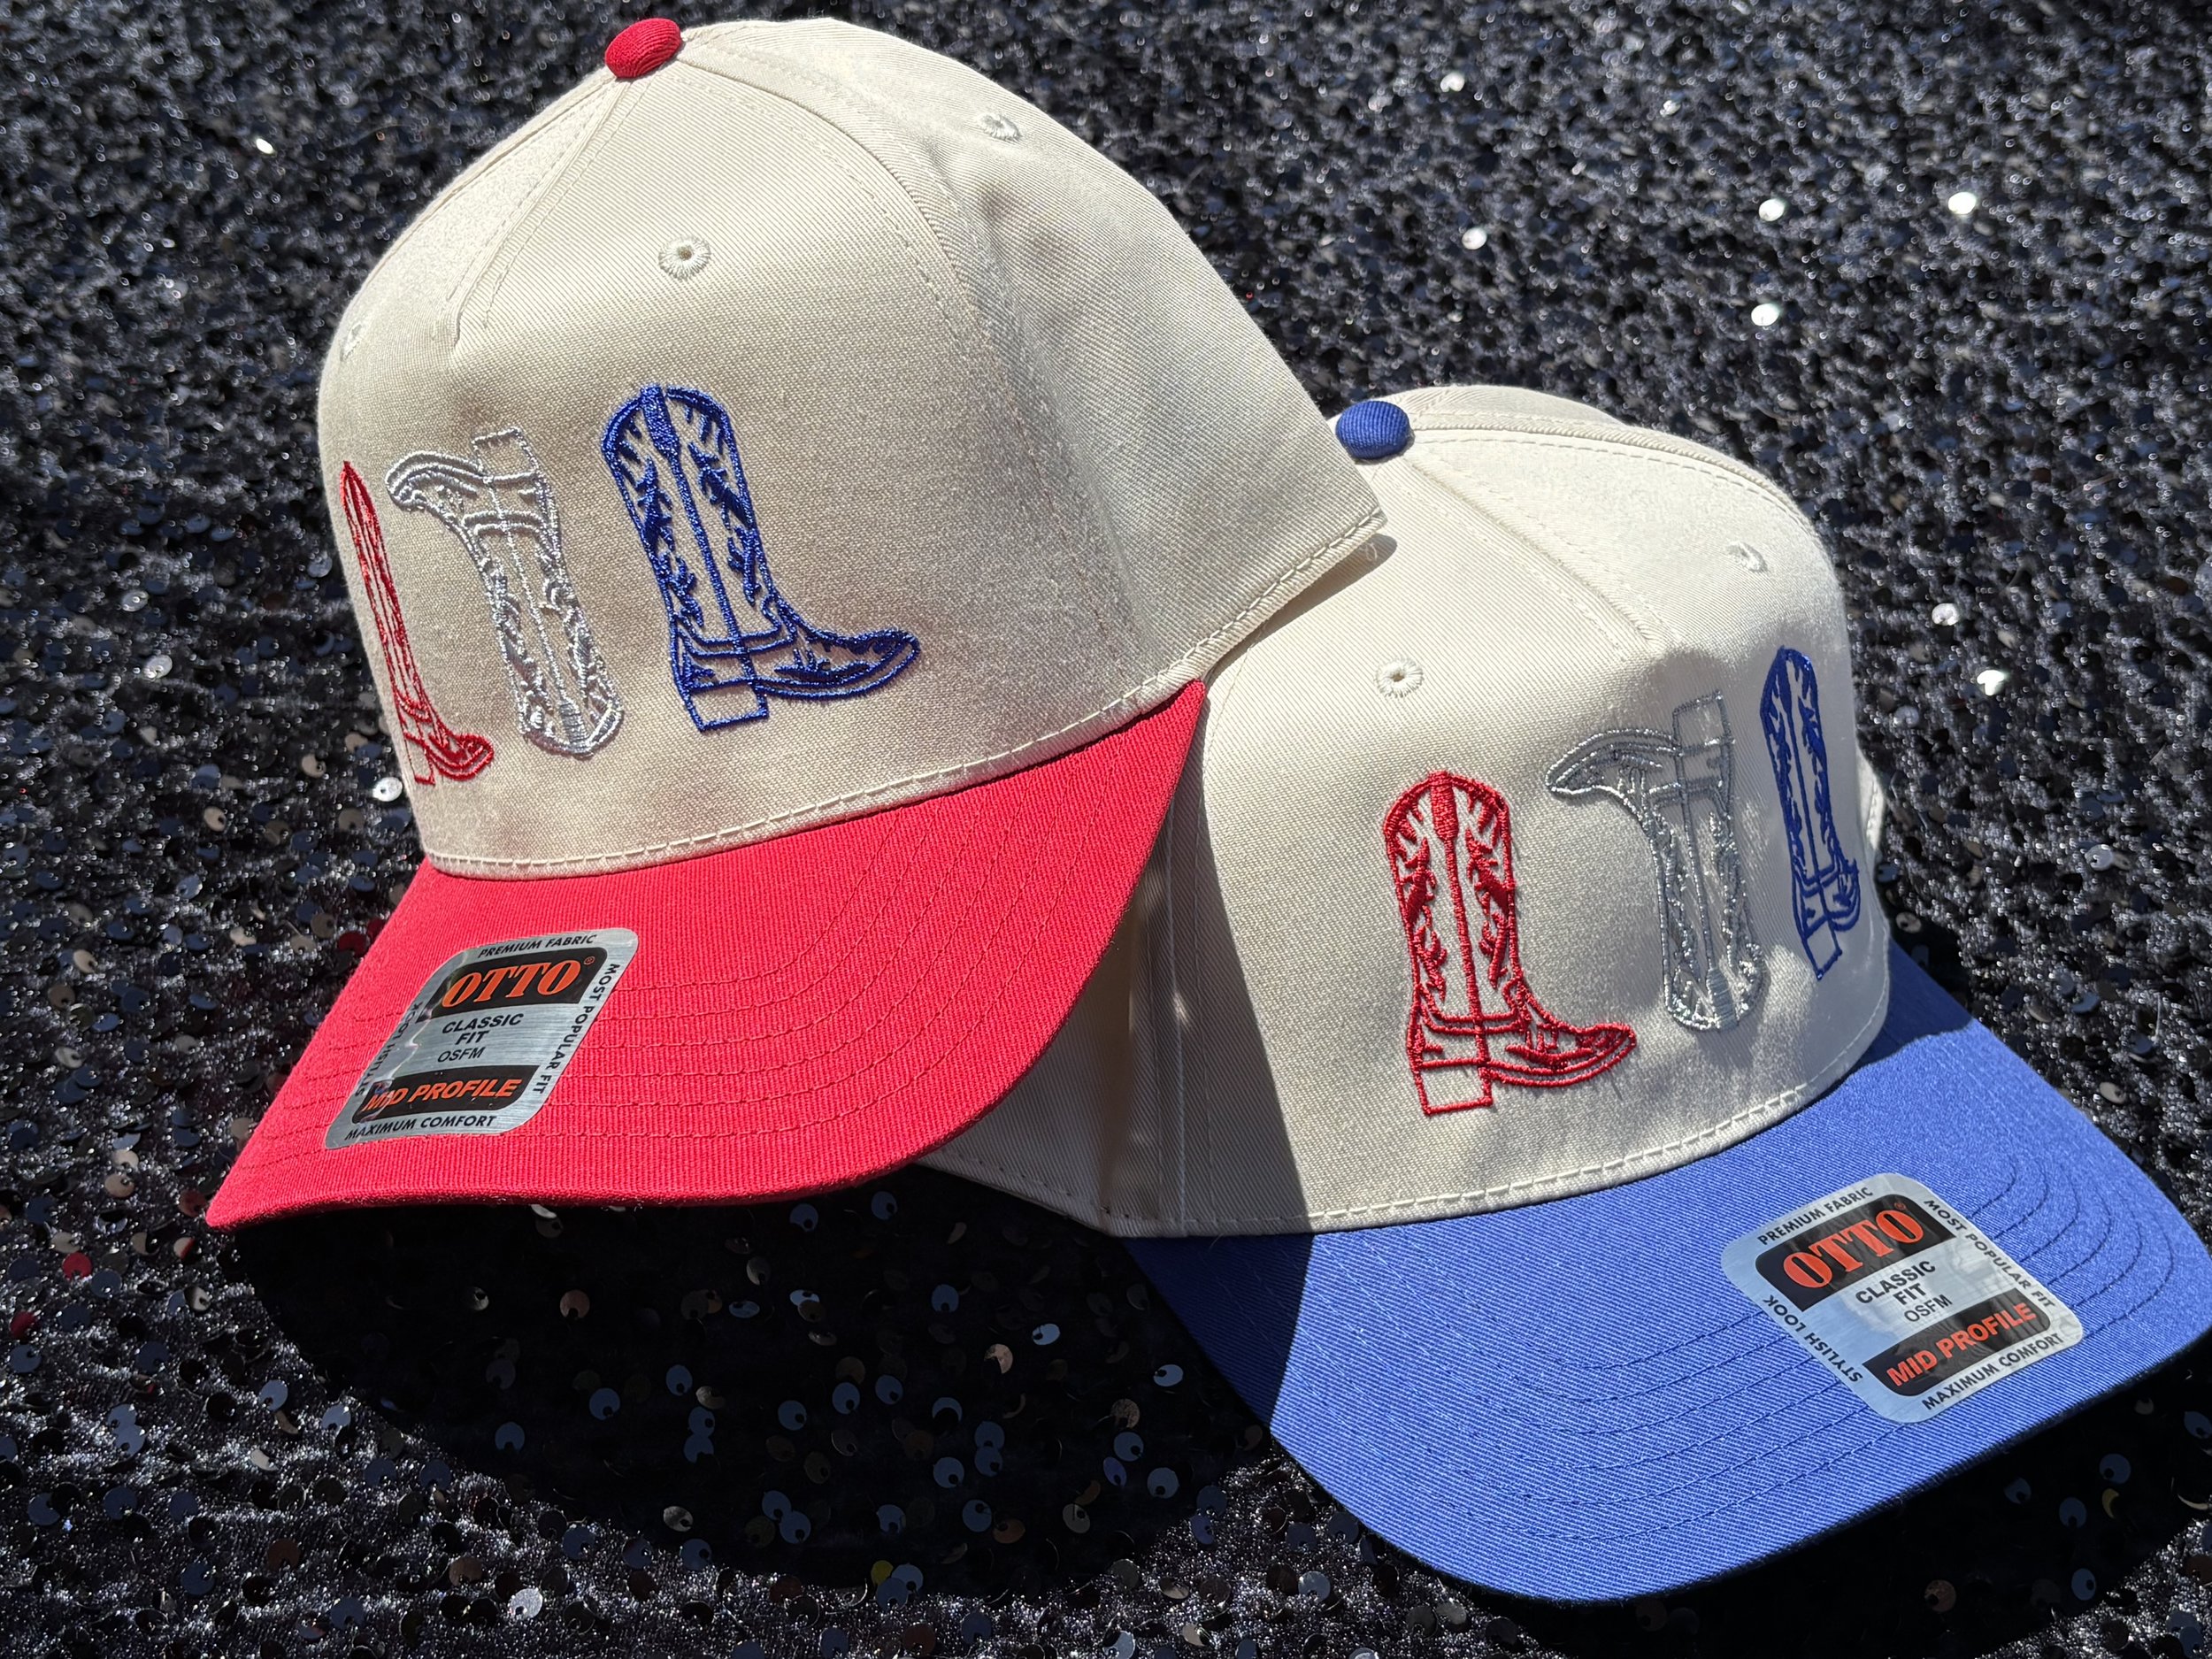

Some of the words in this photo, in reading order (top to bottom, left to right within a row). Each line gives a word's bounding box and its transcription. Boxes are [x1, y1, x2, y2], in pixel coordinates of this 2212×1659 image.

[478, 940, 541, 959] PREMIUM
[545, 935, 597, 948] FABRIC
[591, 964, 620, 1002] MOST
[442, 1013, 524, 1033] CLASSIC
[456, 1031, 488, 1045] FIT
[549, 1005, 595, 1070] POPULAR
[437, 1048, 486, 1063] OSFM
[363, 1087, 406, 1111] MID
[411, 1079, 523, 1102] PROFILE
[533, 1067, 555, 1094] FIT
[345, 1118, 418, 1140] MAXIMUM
[421, 1116, 496, 1129] COMFORT
[1757, 1207, 1826, 1246] PREMIUM
[1824, 1187, 1873, 1213] FABRIC
[1924, 1200, 1964, 1232] MOST
[1969, 1233, 2030, 1290] POPULAR
[2031, 1290, 2055, 1309] FIT
[1855, 1261, 1936, 1304] CLASSIC
[1897, 1283, 1930, 1305] FIT
[1763, 1294, 1806, 1328] LOOK
[1904, 1294, 1953, 1323] OSFM
[1803, 1334, 1863, 1382] STYLISH
[1887, 1349, 1937, 1387] MID
[1936, 1302, 2036, 1359] PROFILE
[1923, 1363, 1999, 1410] MAXIMUM
[1999, 1333, 2063, 1368] COMFORT
